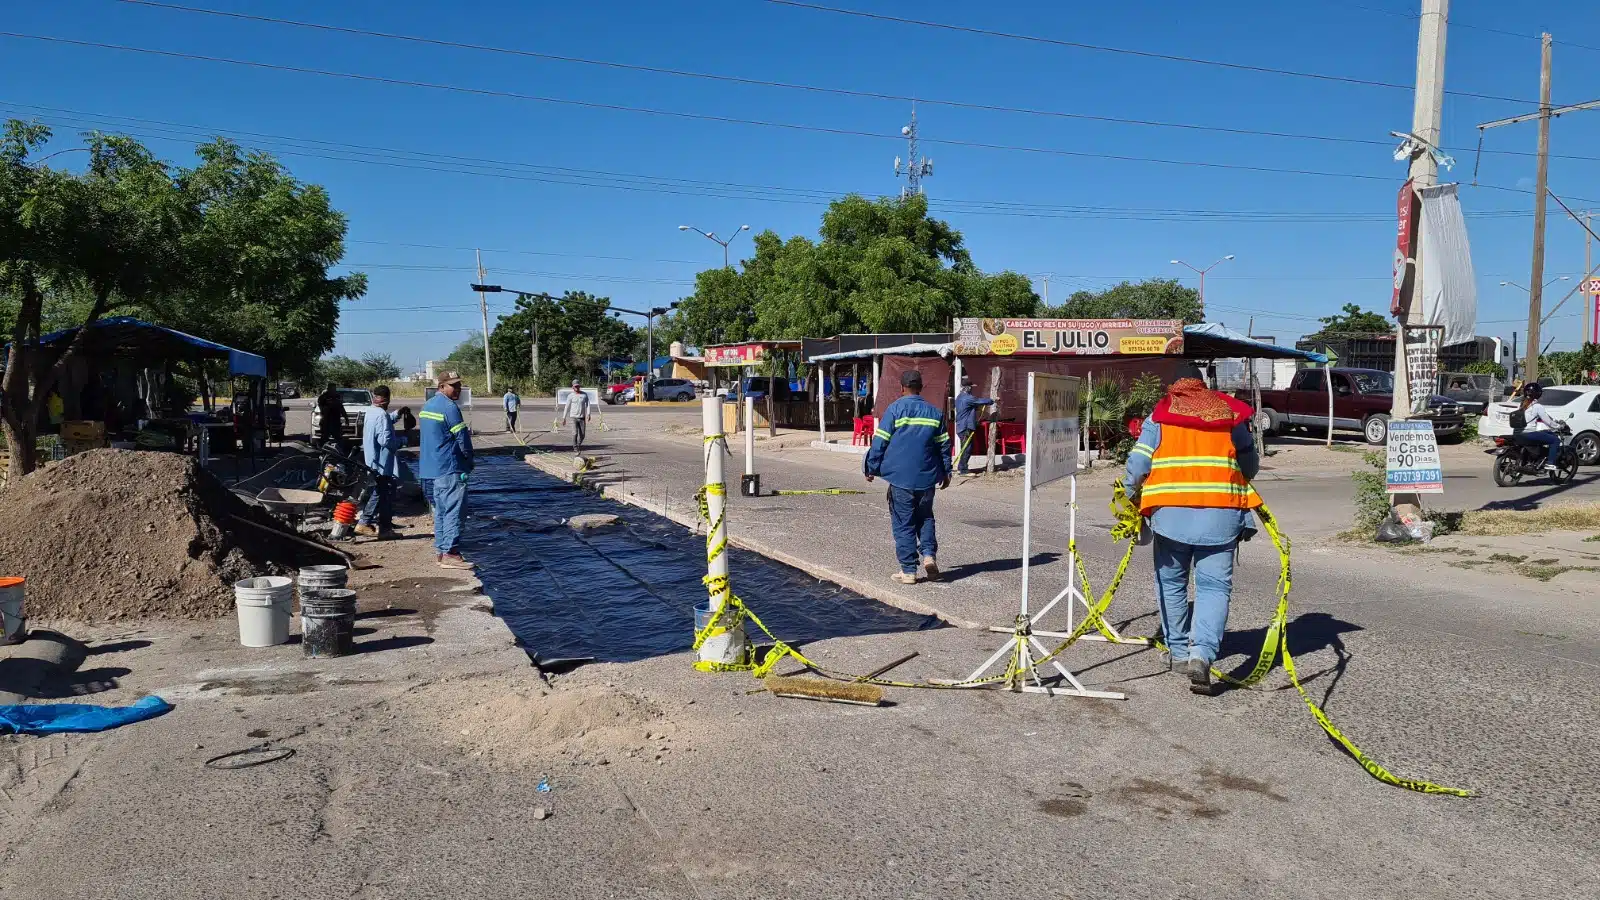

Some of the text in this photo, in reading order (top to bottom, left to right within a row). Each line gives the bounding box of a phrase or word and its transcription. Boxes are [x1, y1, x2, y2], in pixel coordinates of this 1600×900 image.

[1024, 331, 1046, 348] EL
[1052, 331, 1109, 352] JULIO
[1389, 432, 1435, 441] Vendemos
[1399, 443, 1435, 453] Casa
[1397, 454, 1413, 467] 90
[1394, 470, 1440, 482] 6737397391
